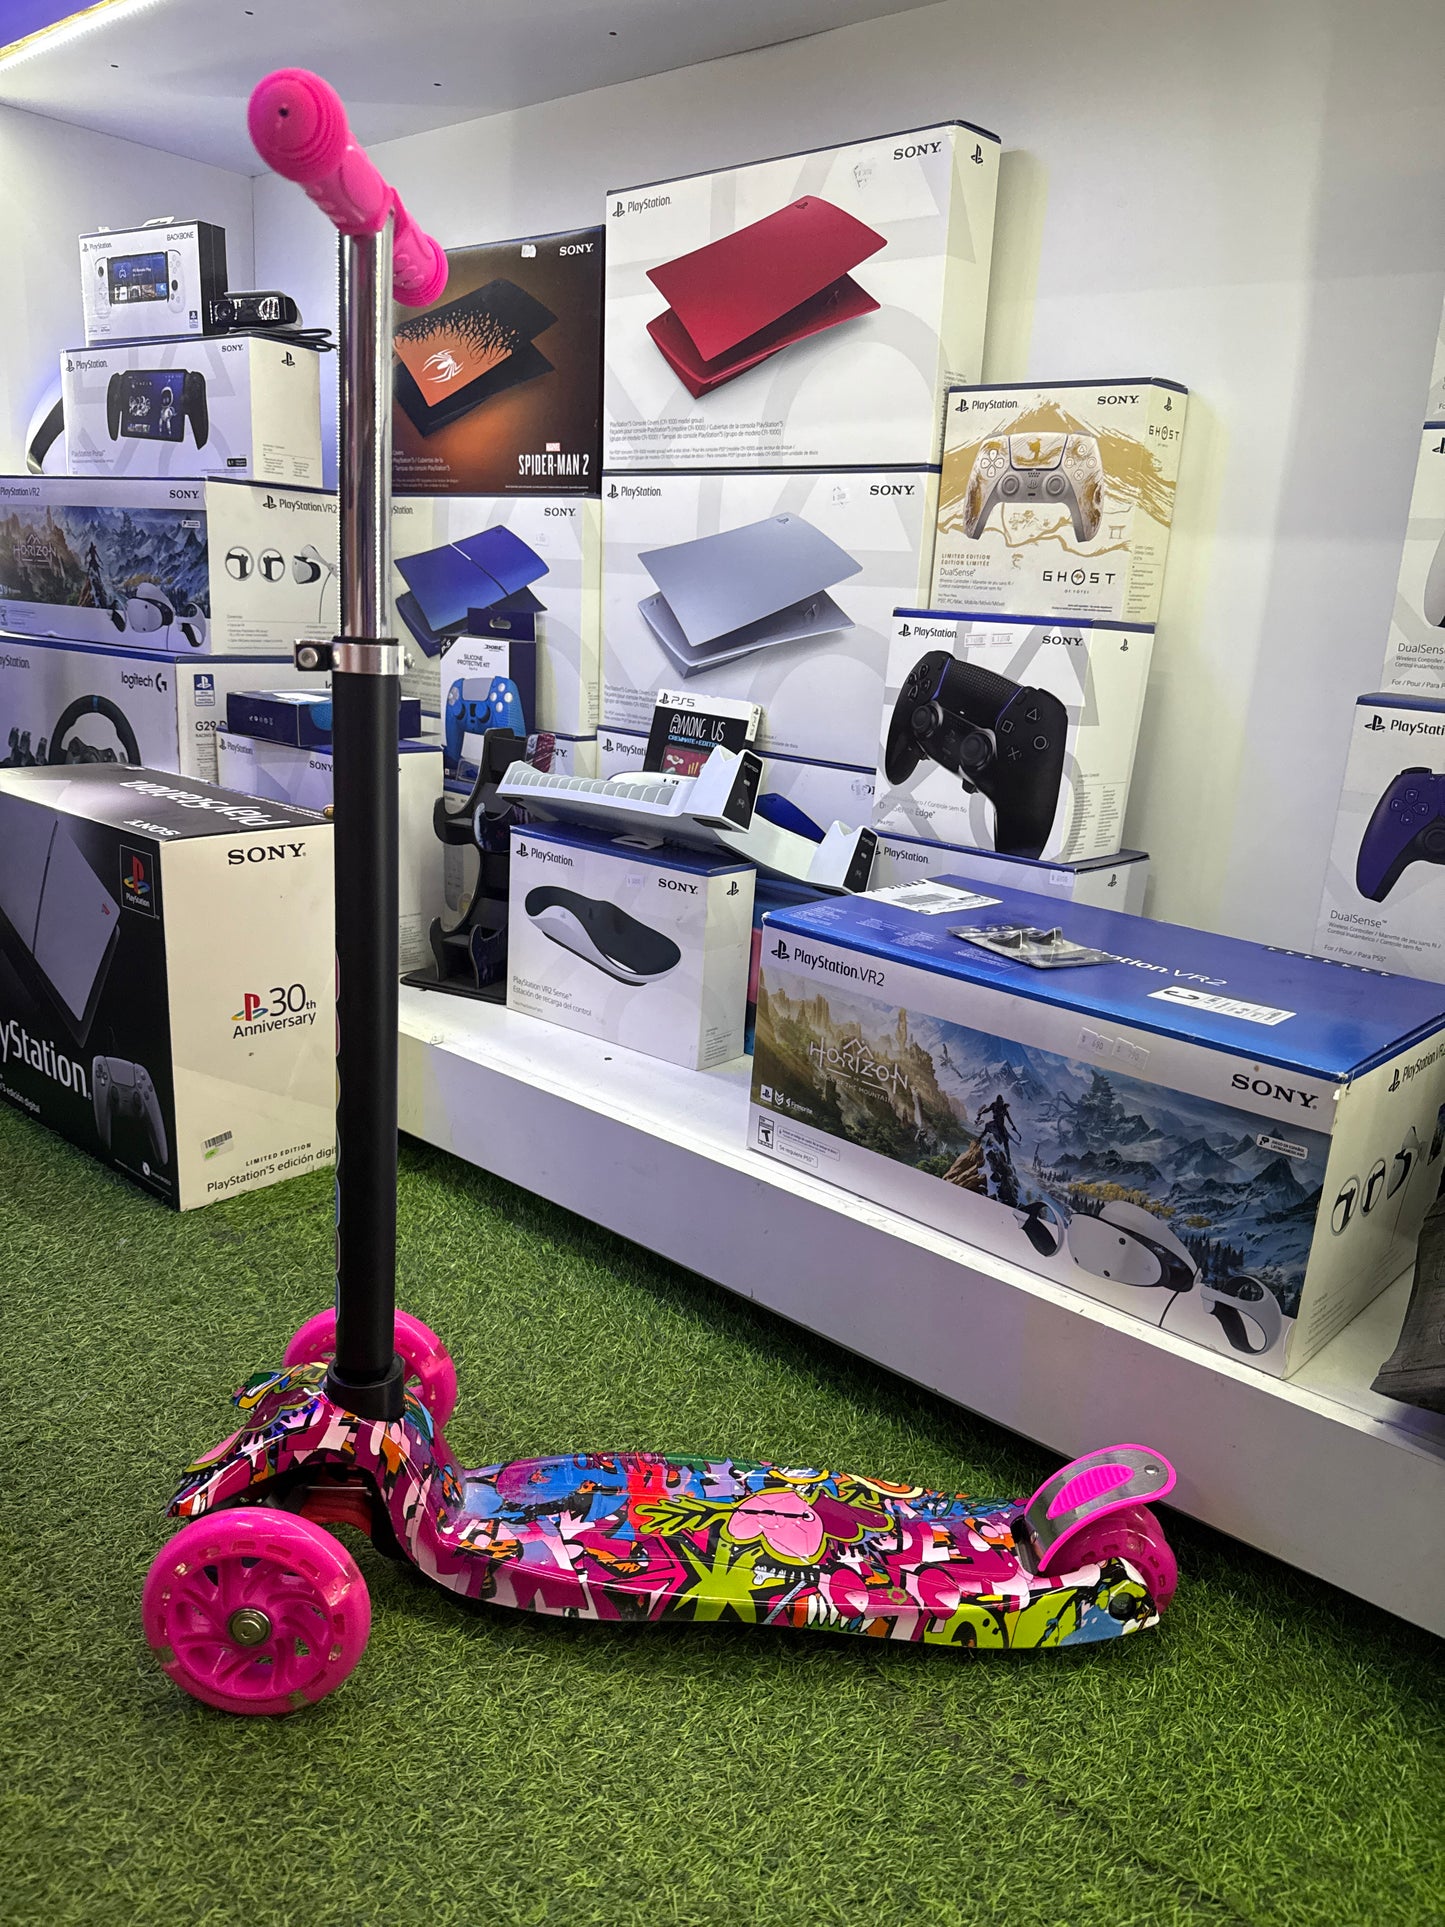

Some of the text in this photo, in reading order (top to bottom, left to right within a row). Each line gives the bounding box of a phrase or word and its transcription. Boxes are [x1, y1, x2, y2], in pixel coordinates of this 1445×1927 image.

[893, 141, 942, 160] SONY
[628, 196, 671, 214] PlayStation
[167, 231, 194, 241] BACKBONE
[90, 242, 113, 251] PlayStation
[559, 243, 594, 256] SONY
[221, 344, 243, 353] SONY
[76, 360, 108, 370] PlayStation
[972, 399, 1018, 411] PlayStation
[1097, 395, 1140, 405] SONY
[1148, 425, 1180, 440] GHOST
[582, 453, 589, 476] 2
[169, 490, 200, 499] SONY
[620, 485, 661, 500] PlayStation
[869, 485, 914, 496] SONY
[279, 498, 337, 514] PlayStation VR2
[393, 505, 413, 514] Station
[544, 507, 575, 517] SONY
[13, 542, 56, 561] HORIZON
[1042, 568, 1116, 586] GHOST
[914, 627, 957, 639] PlayStation
[1042, 635, 1083, 646] SONY
[0, 655, 30, 669] ayStation
[121, 671, 153, 689] logitech
[671, 696, 695, 707] PS5
[195, 720, 216, 731] G29
[669, 713, 727, 742] AMONG US
[1390, 719, 1445, 736] PlayStati
[227, 742, 254, 755] PlayStation
[616, 743, 646, 756] PlayStati
[698, 740, 720, 748] EDITIO
[309, 761, 333, 772] SONY
[119, 780, 291, 827] PlayStation
[124, 819, 181, 836] SONY
[228, 843, 306, 865] SONY
[531, 847, 573, 867] PlayStation
[884, 847, 929, 864] PlayStation
[658, 878, 699, 895] SONY
[126, 892, 150, 908] PlayStation
[1338, 947, 1352, 955] Pour
[1358, 951, 1371, 959] Para
[794, 948, 885, 987] PlayStation VR2
[1173, 969, 1228, 986] VR2
[535, 992, 542, 1000] de
[233, 1012, 316, 1039] Anniversary
[0, 1020, 87, 1098] yStation
[810, 1037, 908, 1094] HORIZON
[1402, 1052, 1435, 1082] PlayStation
[1232, 1073, 1318, 1109] SONY
[761, 1129, 771, 1142] T
[246, 1142, 312, 1166] LIMITED EDITION
[277, 1152, 314, 1171] edición
